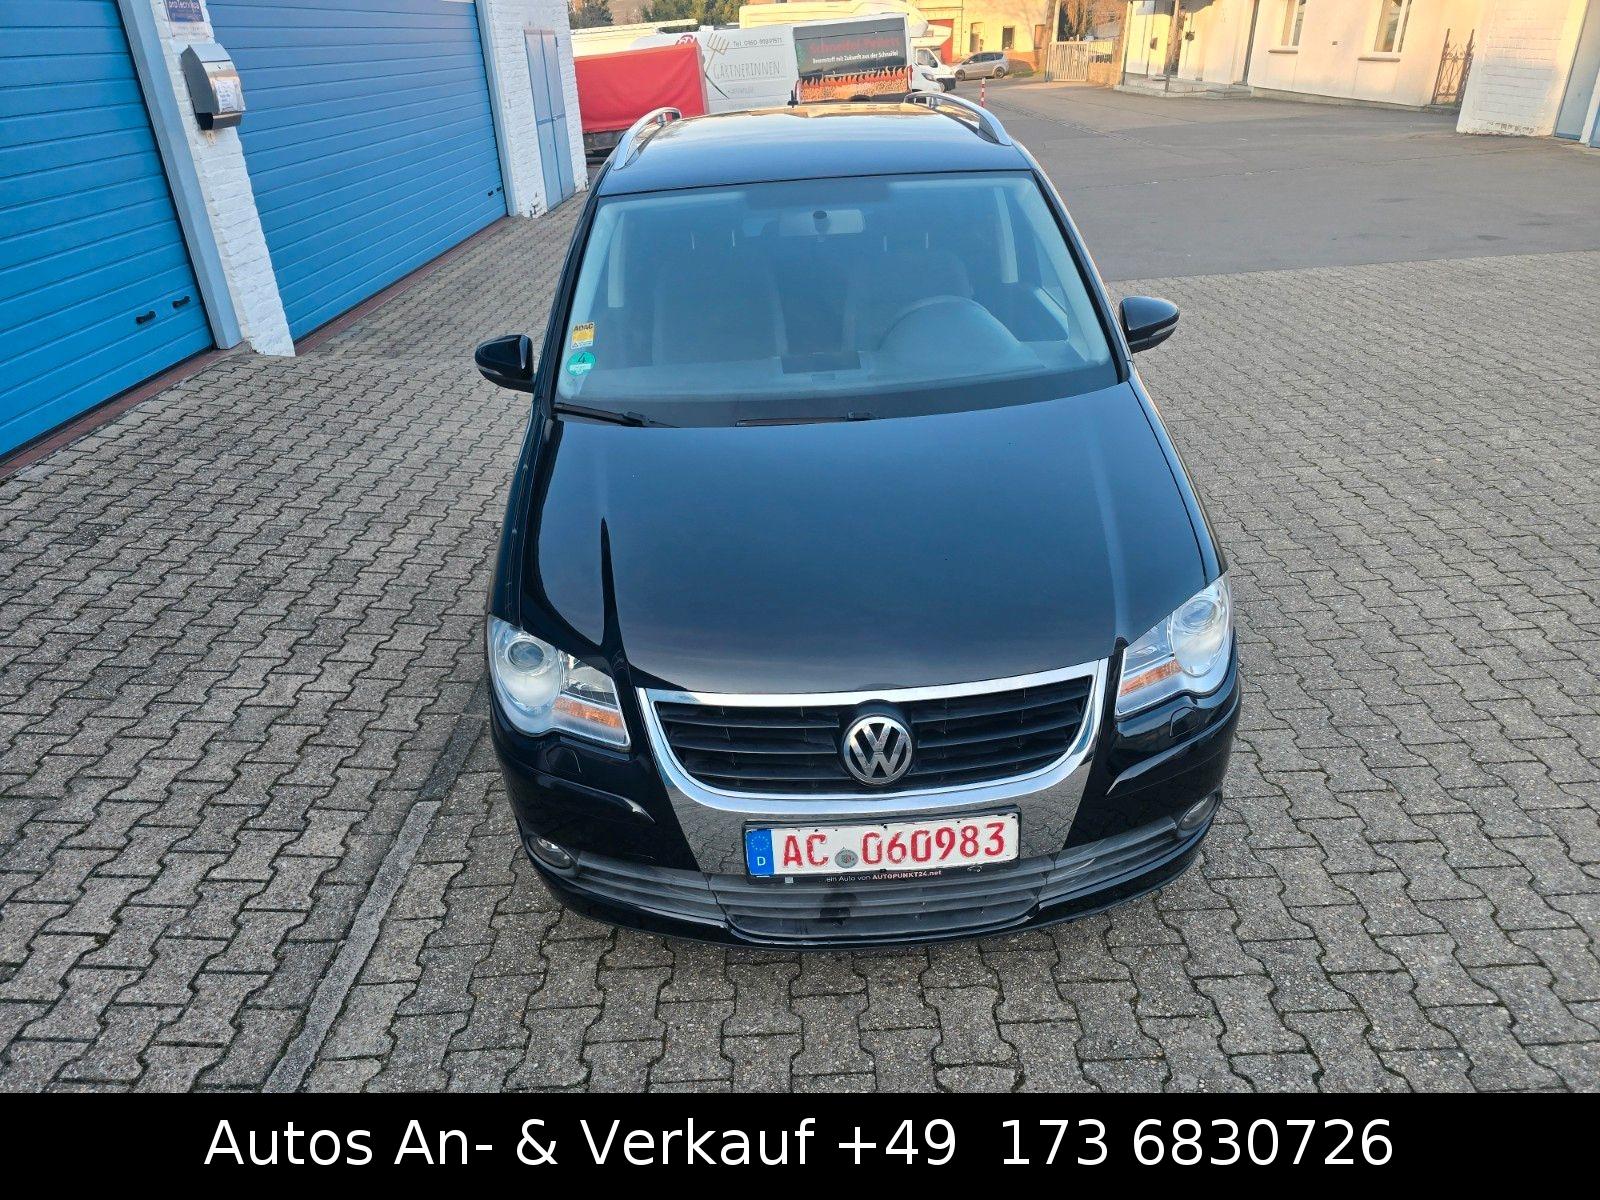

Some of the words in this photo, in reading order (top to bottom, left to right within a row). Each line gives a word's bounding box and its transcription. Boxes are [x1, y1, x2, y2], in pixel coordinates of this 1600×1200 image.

[577, 353, 585, 363] 4
[783, 834, 829, 867] AC
[861, 821, 1005, 866] 060983
[757, 856, 766, 866] D
[872, 870, 942, 881] AUTOPUNKT24.net
